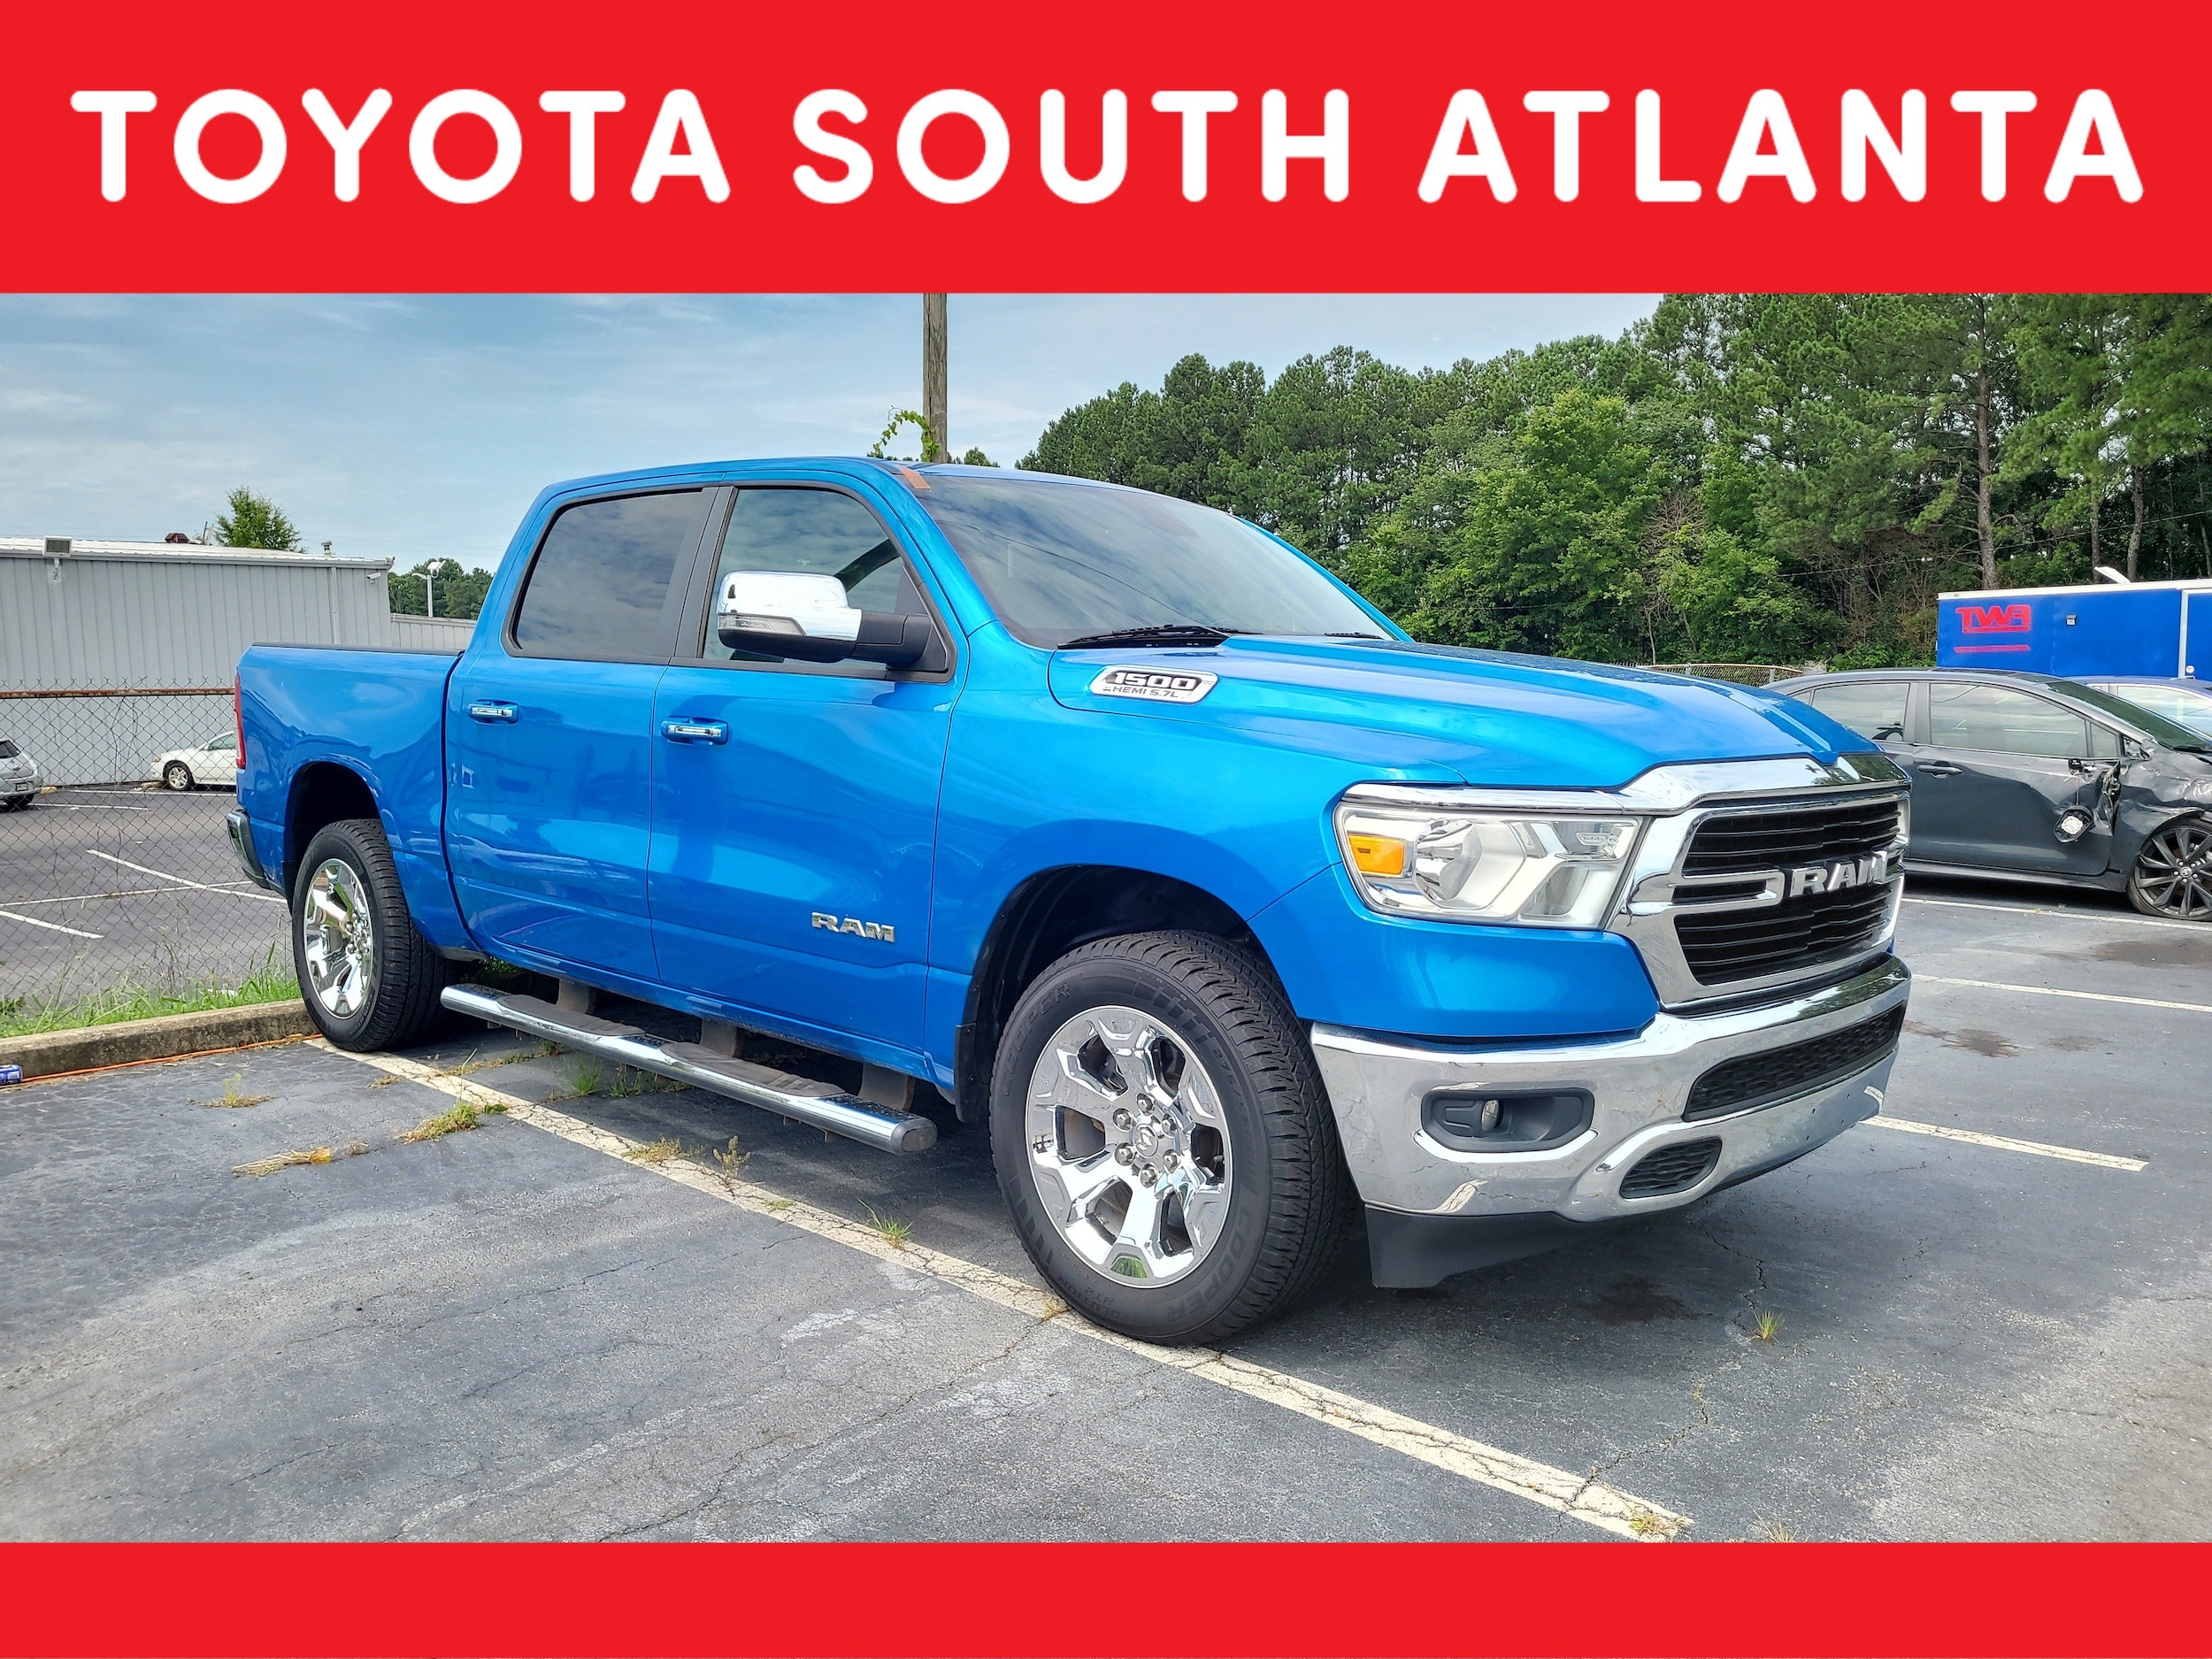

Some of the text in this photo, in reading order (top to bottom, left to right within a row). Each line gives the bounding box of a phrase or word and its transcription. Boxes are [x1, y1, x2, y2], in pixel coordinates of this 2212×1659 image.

[1112, 686, 1179, 698] HEMI 5.7L
[1115, 672, 1198, 691] 1500
[1790, 850, 1887, 898] RAM
[811, 911, 895, 943] RAM
